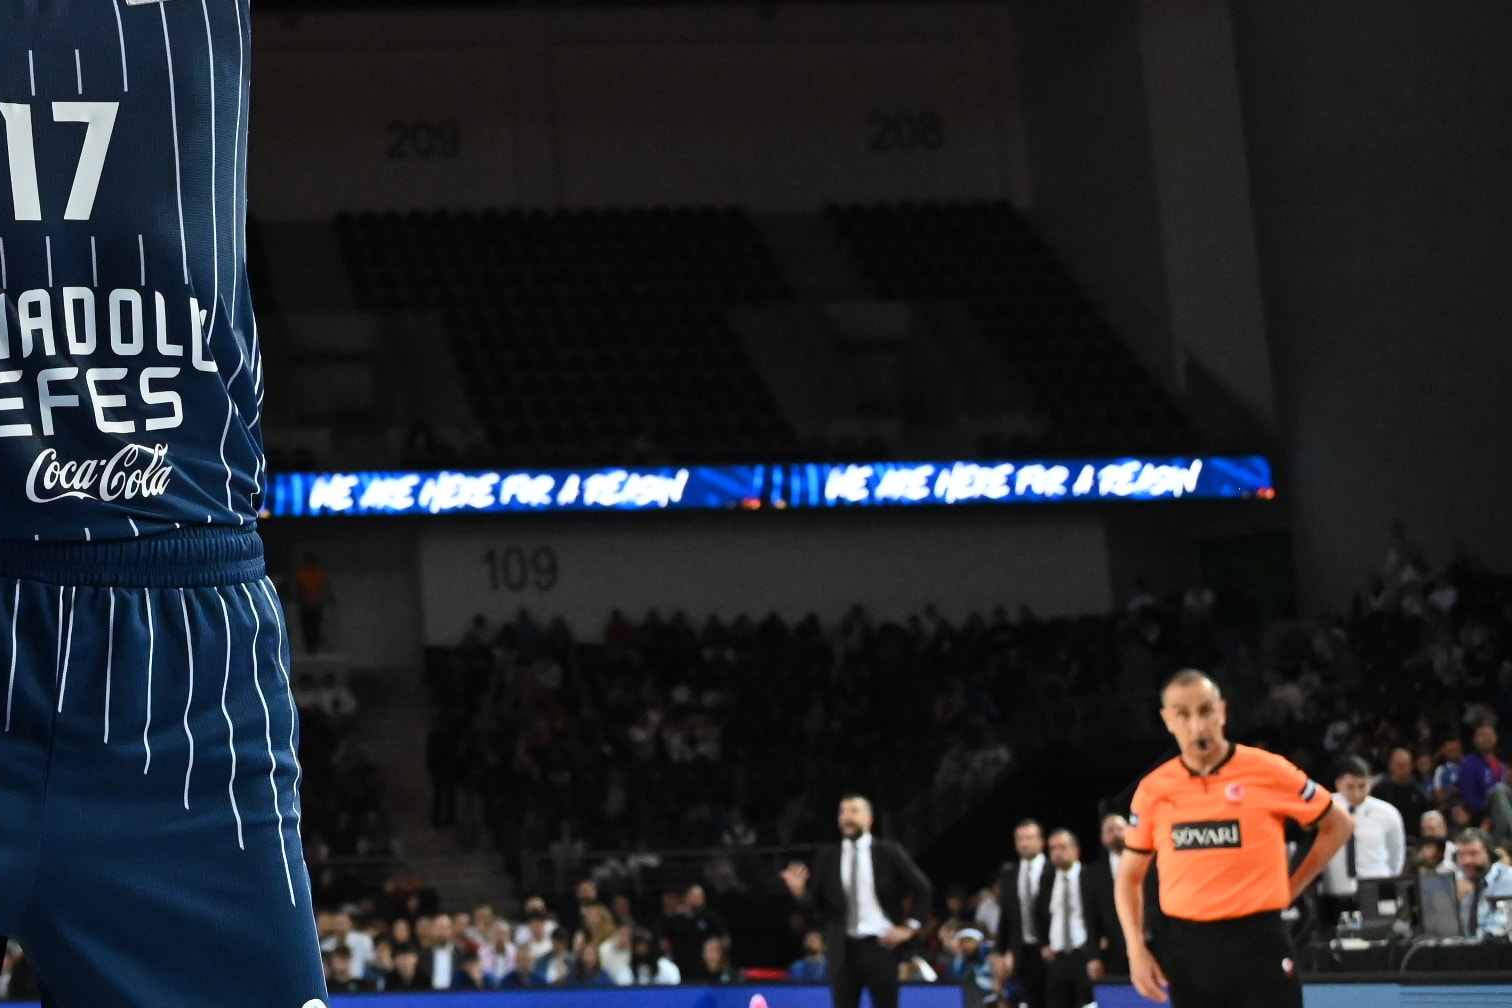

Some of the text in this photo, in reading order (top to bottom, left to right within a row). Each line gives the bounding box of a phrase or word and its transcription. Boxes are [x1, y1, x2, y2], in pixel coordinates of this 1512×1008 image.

[386, 119, 461, 159] 209
[868, 109, 945, 152] 208
[25, 443, 173, 504] Coca-Cola
[483, 546, 559, 593] 109
